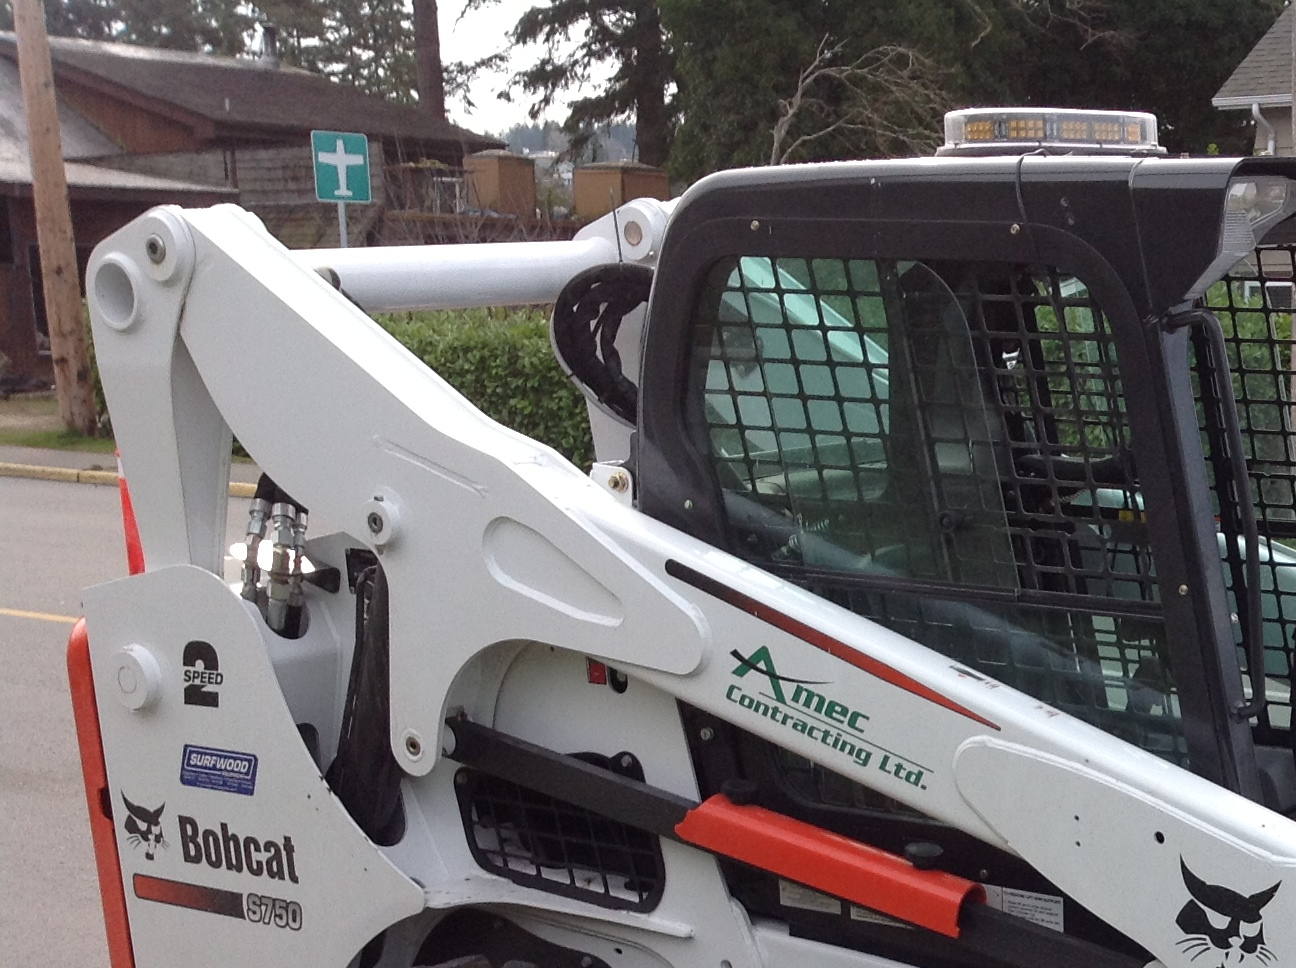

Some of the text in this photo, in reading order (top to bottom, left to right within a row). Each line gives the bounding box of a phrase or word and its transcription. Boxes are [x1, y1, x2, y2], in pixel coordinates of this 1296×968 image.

[183, 640, 219, 708] 2
[183, 669, 224, 686] SPEED
[730, 645, 870, 734] Amec
[189, 753, 250, 773] SURFWOOD
[726, 684, 927, 790] Contracting Ltd.
[178, 815, 299, 885] Bobcat
[246, 892, 303, 931] S750
